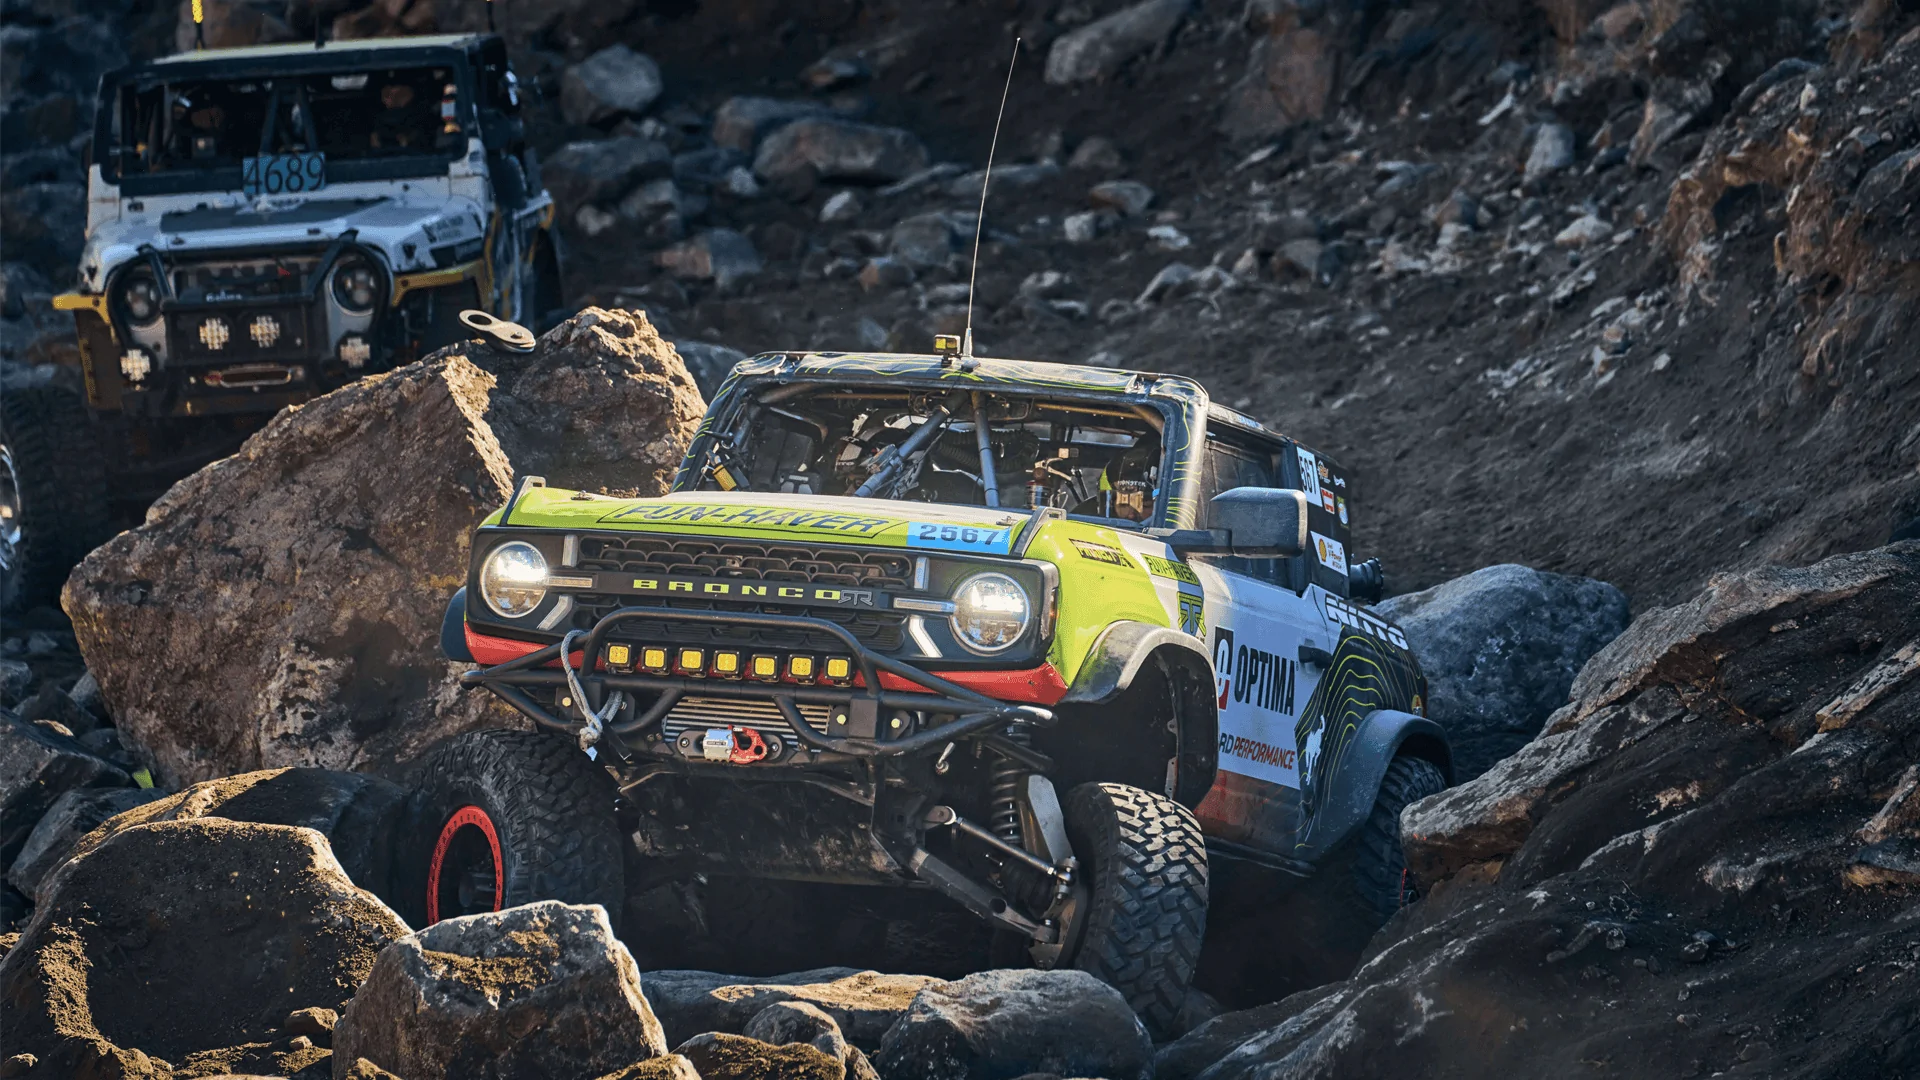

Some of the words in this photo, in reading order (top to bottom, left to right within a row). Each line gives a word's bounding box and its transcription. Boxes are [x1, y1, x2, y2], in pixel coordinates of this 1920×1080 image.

[244, 154, 324, 195] 4689
[615, 505, 890, 533] FUN-HAVER
[920, 524, 1000, 545] 2567
[633, 579, 841, 600] BRONCO
[1325, 594, 1410, 651] NITTO
[1234, 644, 1296, 717] OPTIMA
[1232, 736, 1296, 770] PERFORMANCE
